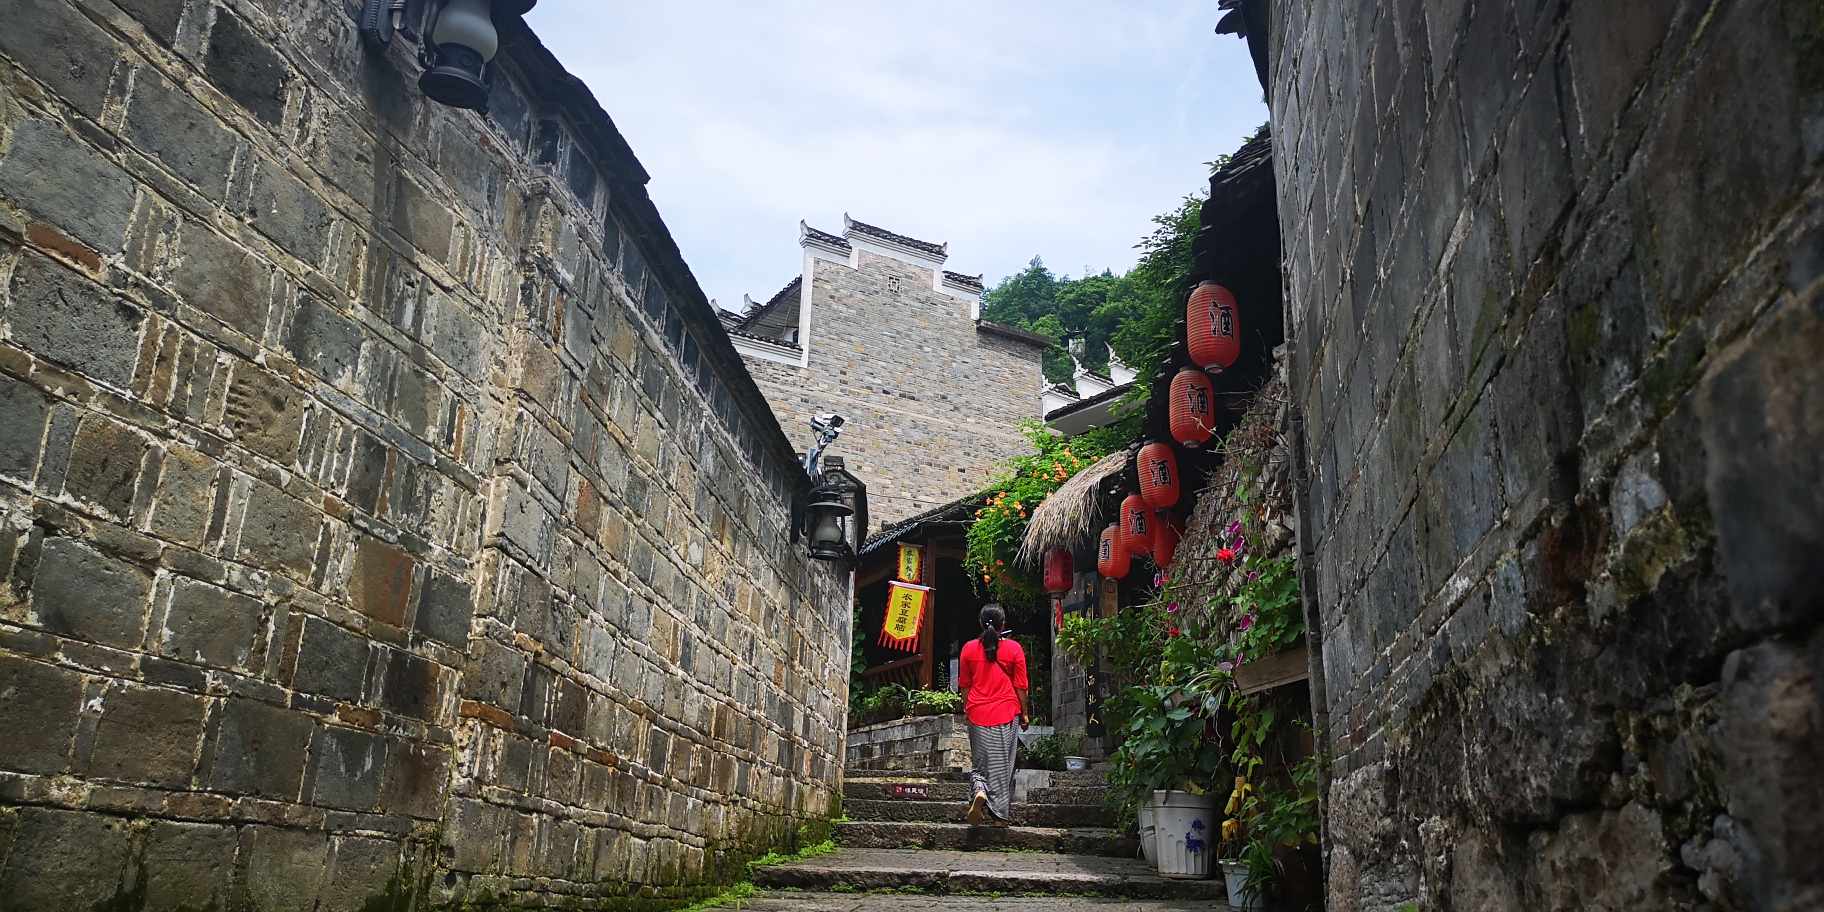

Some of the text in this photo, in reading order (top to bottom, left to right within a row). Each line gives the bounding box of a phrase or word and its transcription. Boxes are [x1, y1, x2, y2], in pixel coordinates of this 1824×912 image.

[1208, 299, 1235, 342] 酒
[1186, 382, 1209, 417] 酒
[1149, 458, 1172, 487] 酒
[1128, 508, 1147, 537] 酒
[894, 593, 913, 632] 农家豆腐脑
